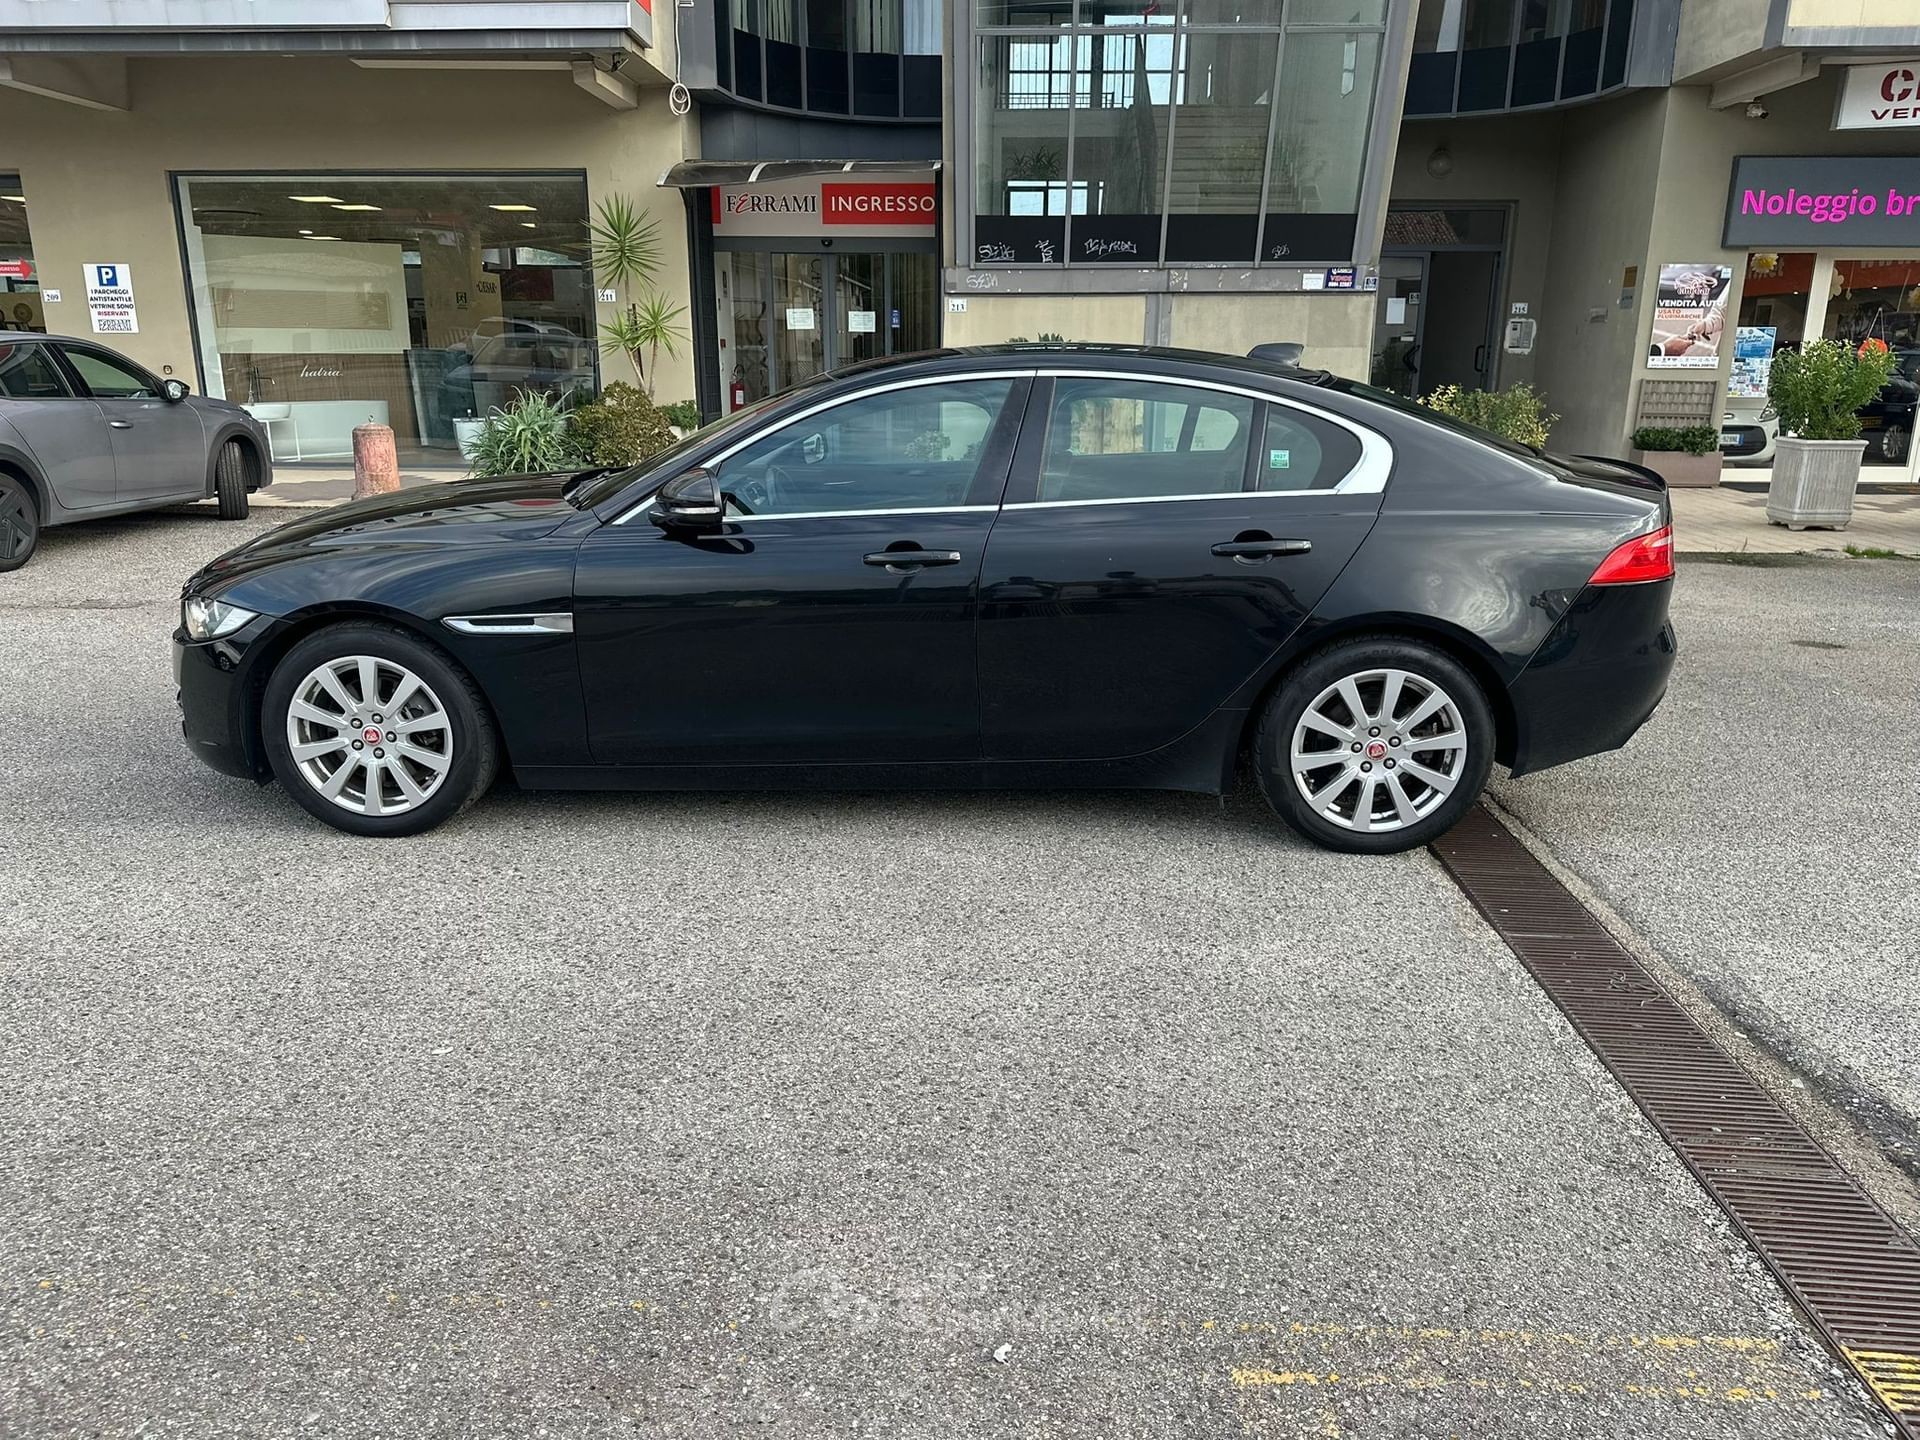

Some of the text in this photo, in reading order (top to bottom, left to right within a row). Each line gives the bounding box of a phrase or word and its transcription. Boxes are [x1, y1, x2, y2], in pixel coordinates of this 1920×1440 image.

[1881, 69, 1920, 102] C
[726, 194, 817, 214] FERRAMI
[832, 196, 935, 212] INGRESSO
[1741, 188, 1877, 223] Noleggio
[100, 267, 114, 285] P
[1658, 299, 1724, 307] VENDITA AUTO
